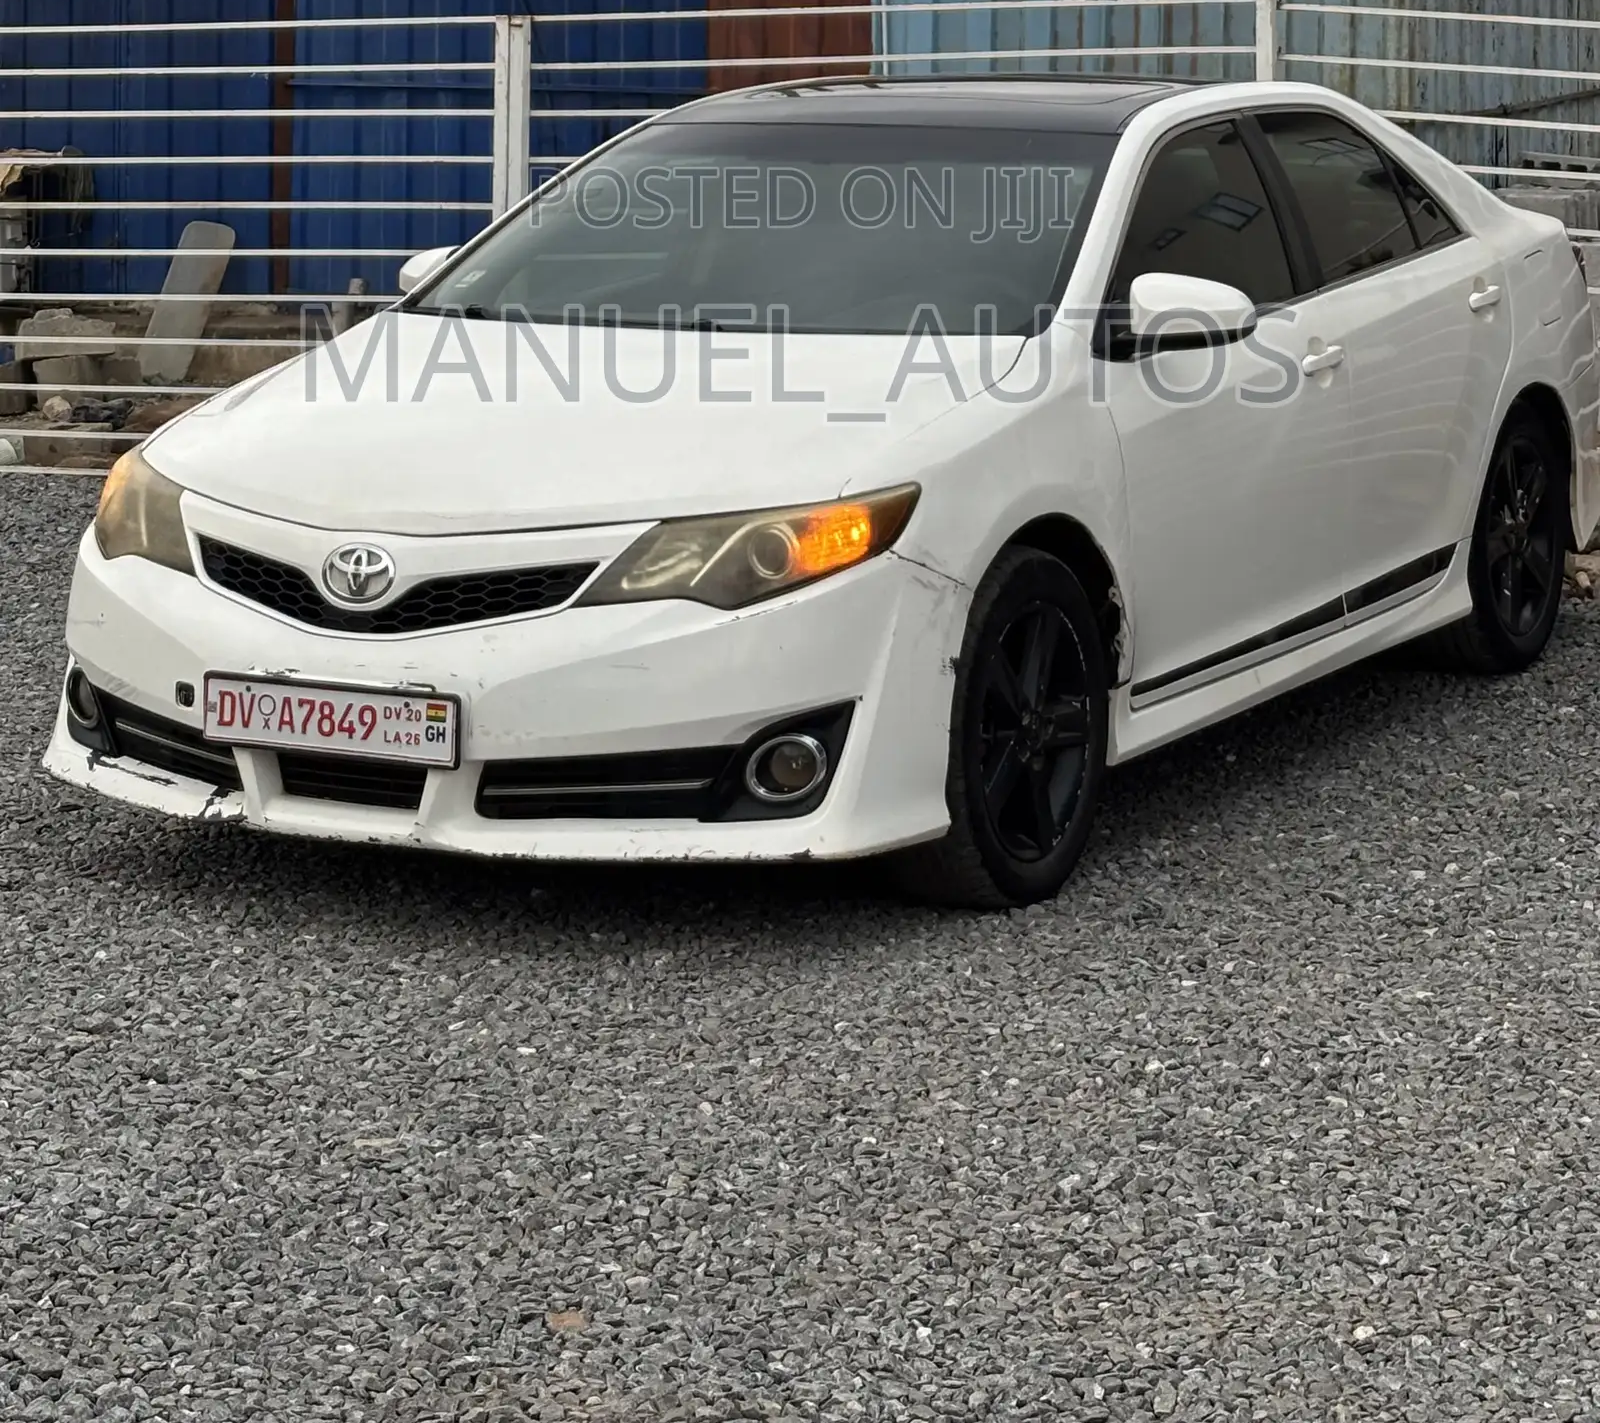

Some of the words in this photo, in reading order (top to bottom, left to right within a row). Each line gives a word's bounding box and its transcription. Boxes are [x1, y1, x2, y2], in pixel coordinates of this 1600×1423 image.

[217, 690, 256, 728] DV
[278, 696, 378, 740] A7849
[383, 706, 402, 720] DV
[406, 708, 422, 722] 20
[384, 730, 402, 743] LA
[405, 732, 421, 746] 26
[425, 724, 446, 743] GH
